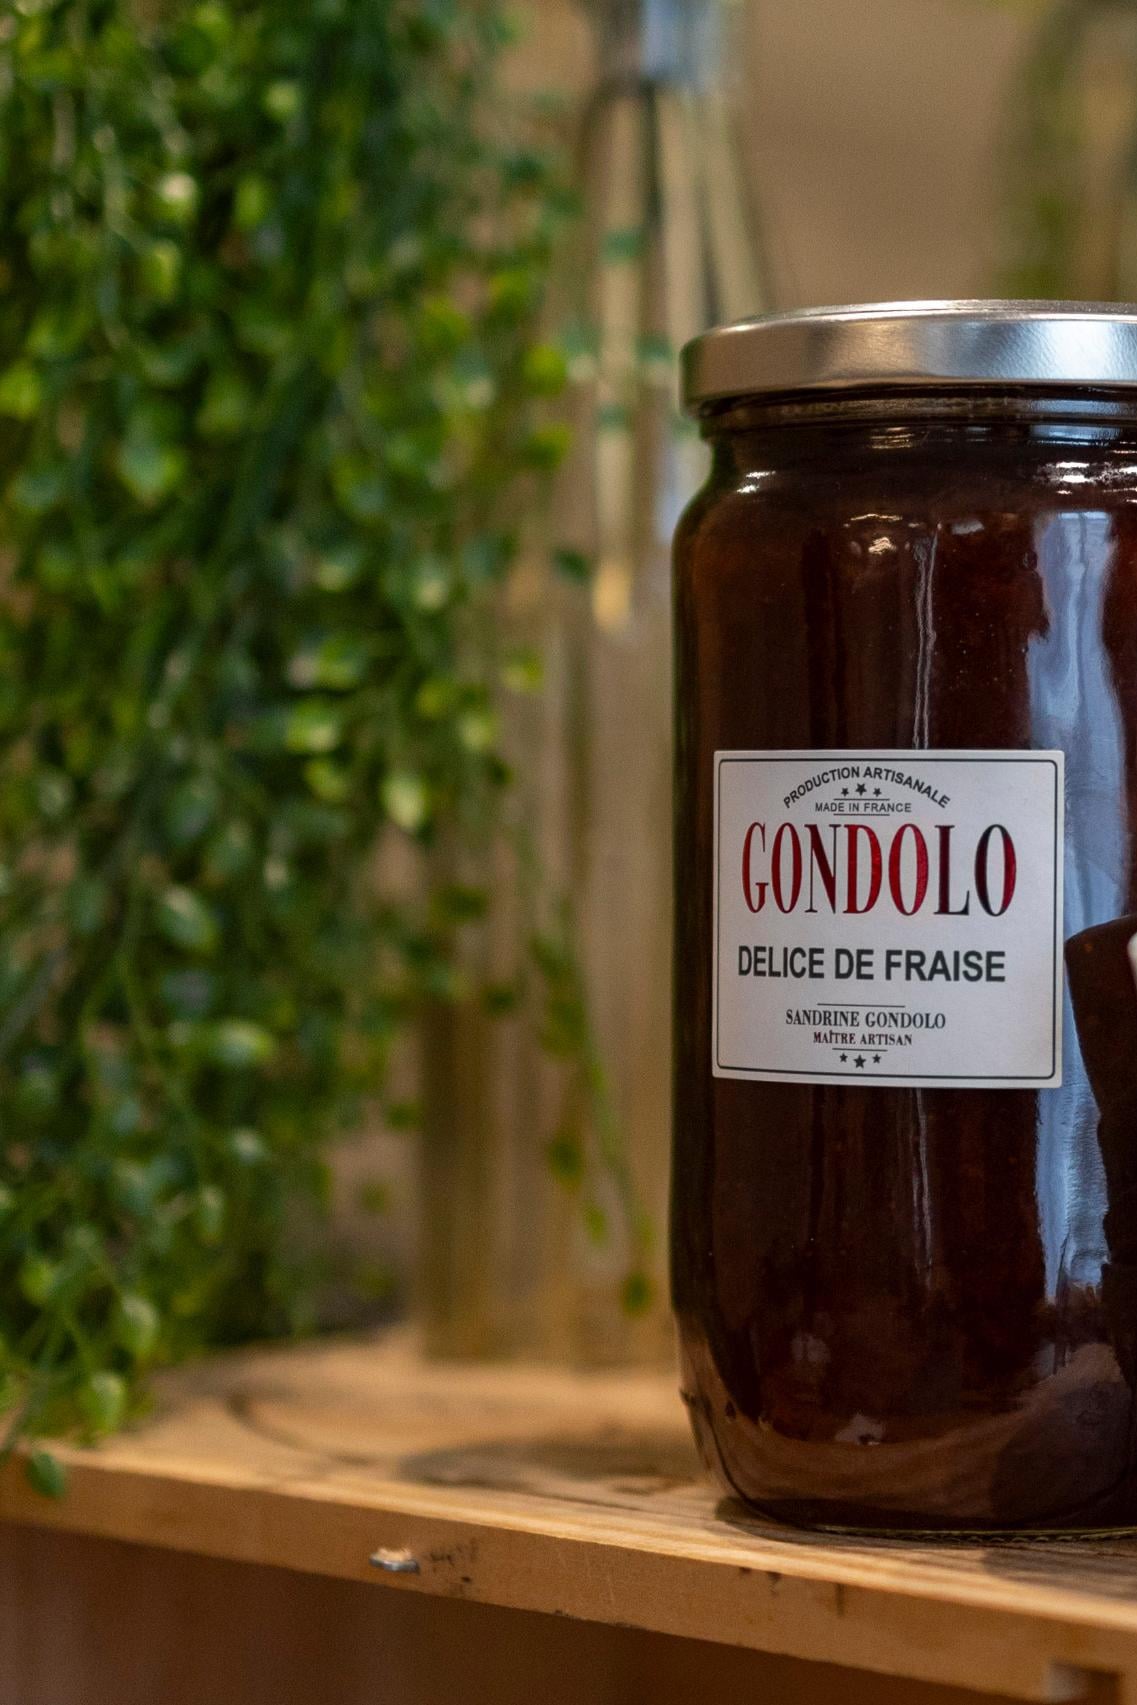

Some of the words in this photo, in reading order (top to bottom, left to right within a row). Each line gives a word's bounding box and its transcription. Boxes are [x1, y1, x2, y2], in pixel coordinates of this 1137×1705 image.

[783, 766, 860, 809] PRODUCTION
[863, 766, 951, 809] ARTISANALE
[815, 801, 845, 813] MADE
[848, 802, 860, 813] IN
[863, 802, 912, 813] FRANCE
[741, 821, 1017, 917] GONDOLO
[738, 945, 825, 979] DELICE
[835, 948, 874, 980] DE
[885, 949, 1006, 982] FRAISE
[785, 1009, 860, 1027] SANDRINE
[865, 1010, 946, 1029] GONDOLO
[860, 1033, 913, 1046] ARTISAN
